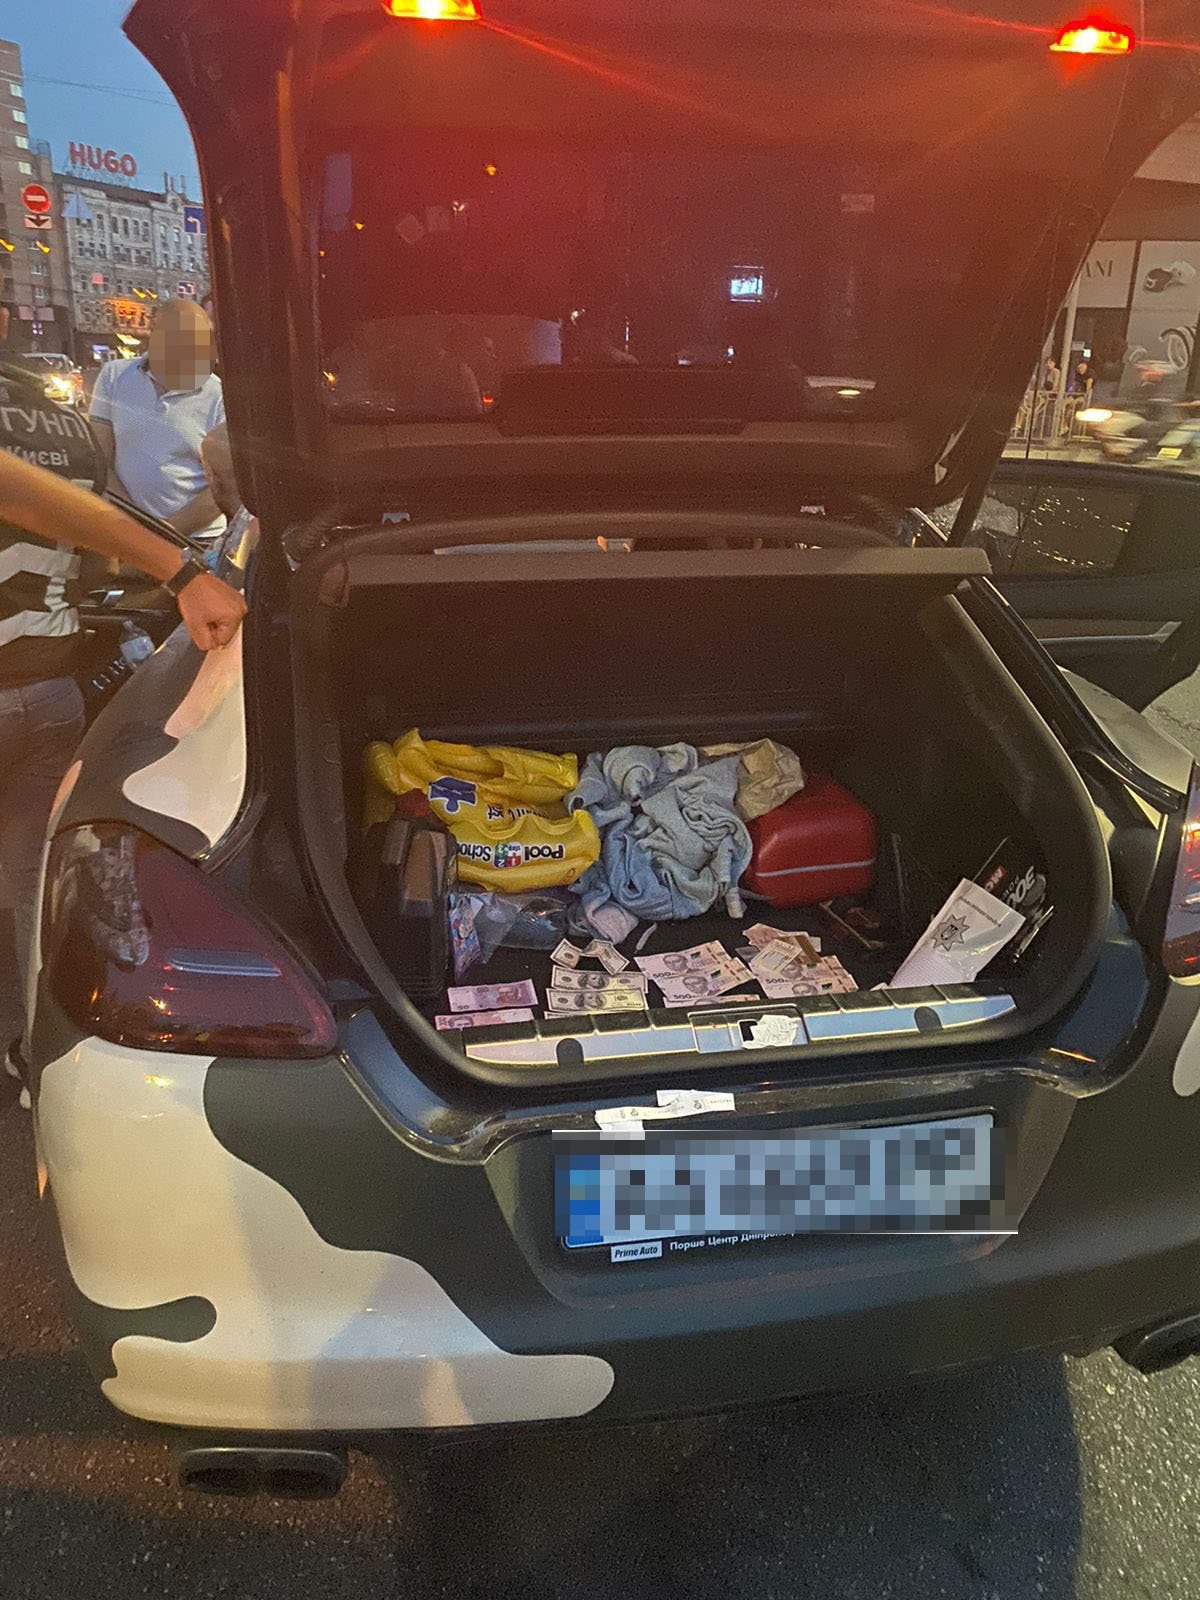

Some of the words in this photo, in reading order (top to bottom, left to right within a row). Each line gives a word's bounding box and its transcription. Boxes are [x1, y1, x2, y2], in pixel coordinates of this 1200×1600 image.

[69, 141, 137, 177] HUGO
[0, 406, 86, 439] ГУНП
[456, 843, 492, 862] Scho
[524, 845, 565, 861] Pool
[670, 1240, 705, 1251] Порше
[708, 1235, 739, 1246] Центр
[614, 1249, 639, 1259] Prime
[640, 1246, 658, 1256] Auto
